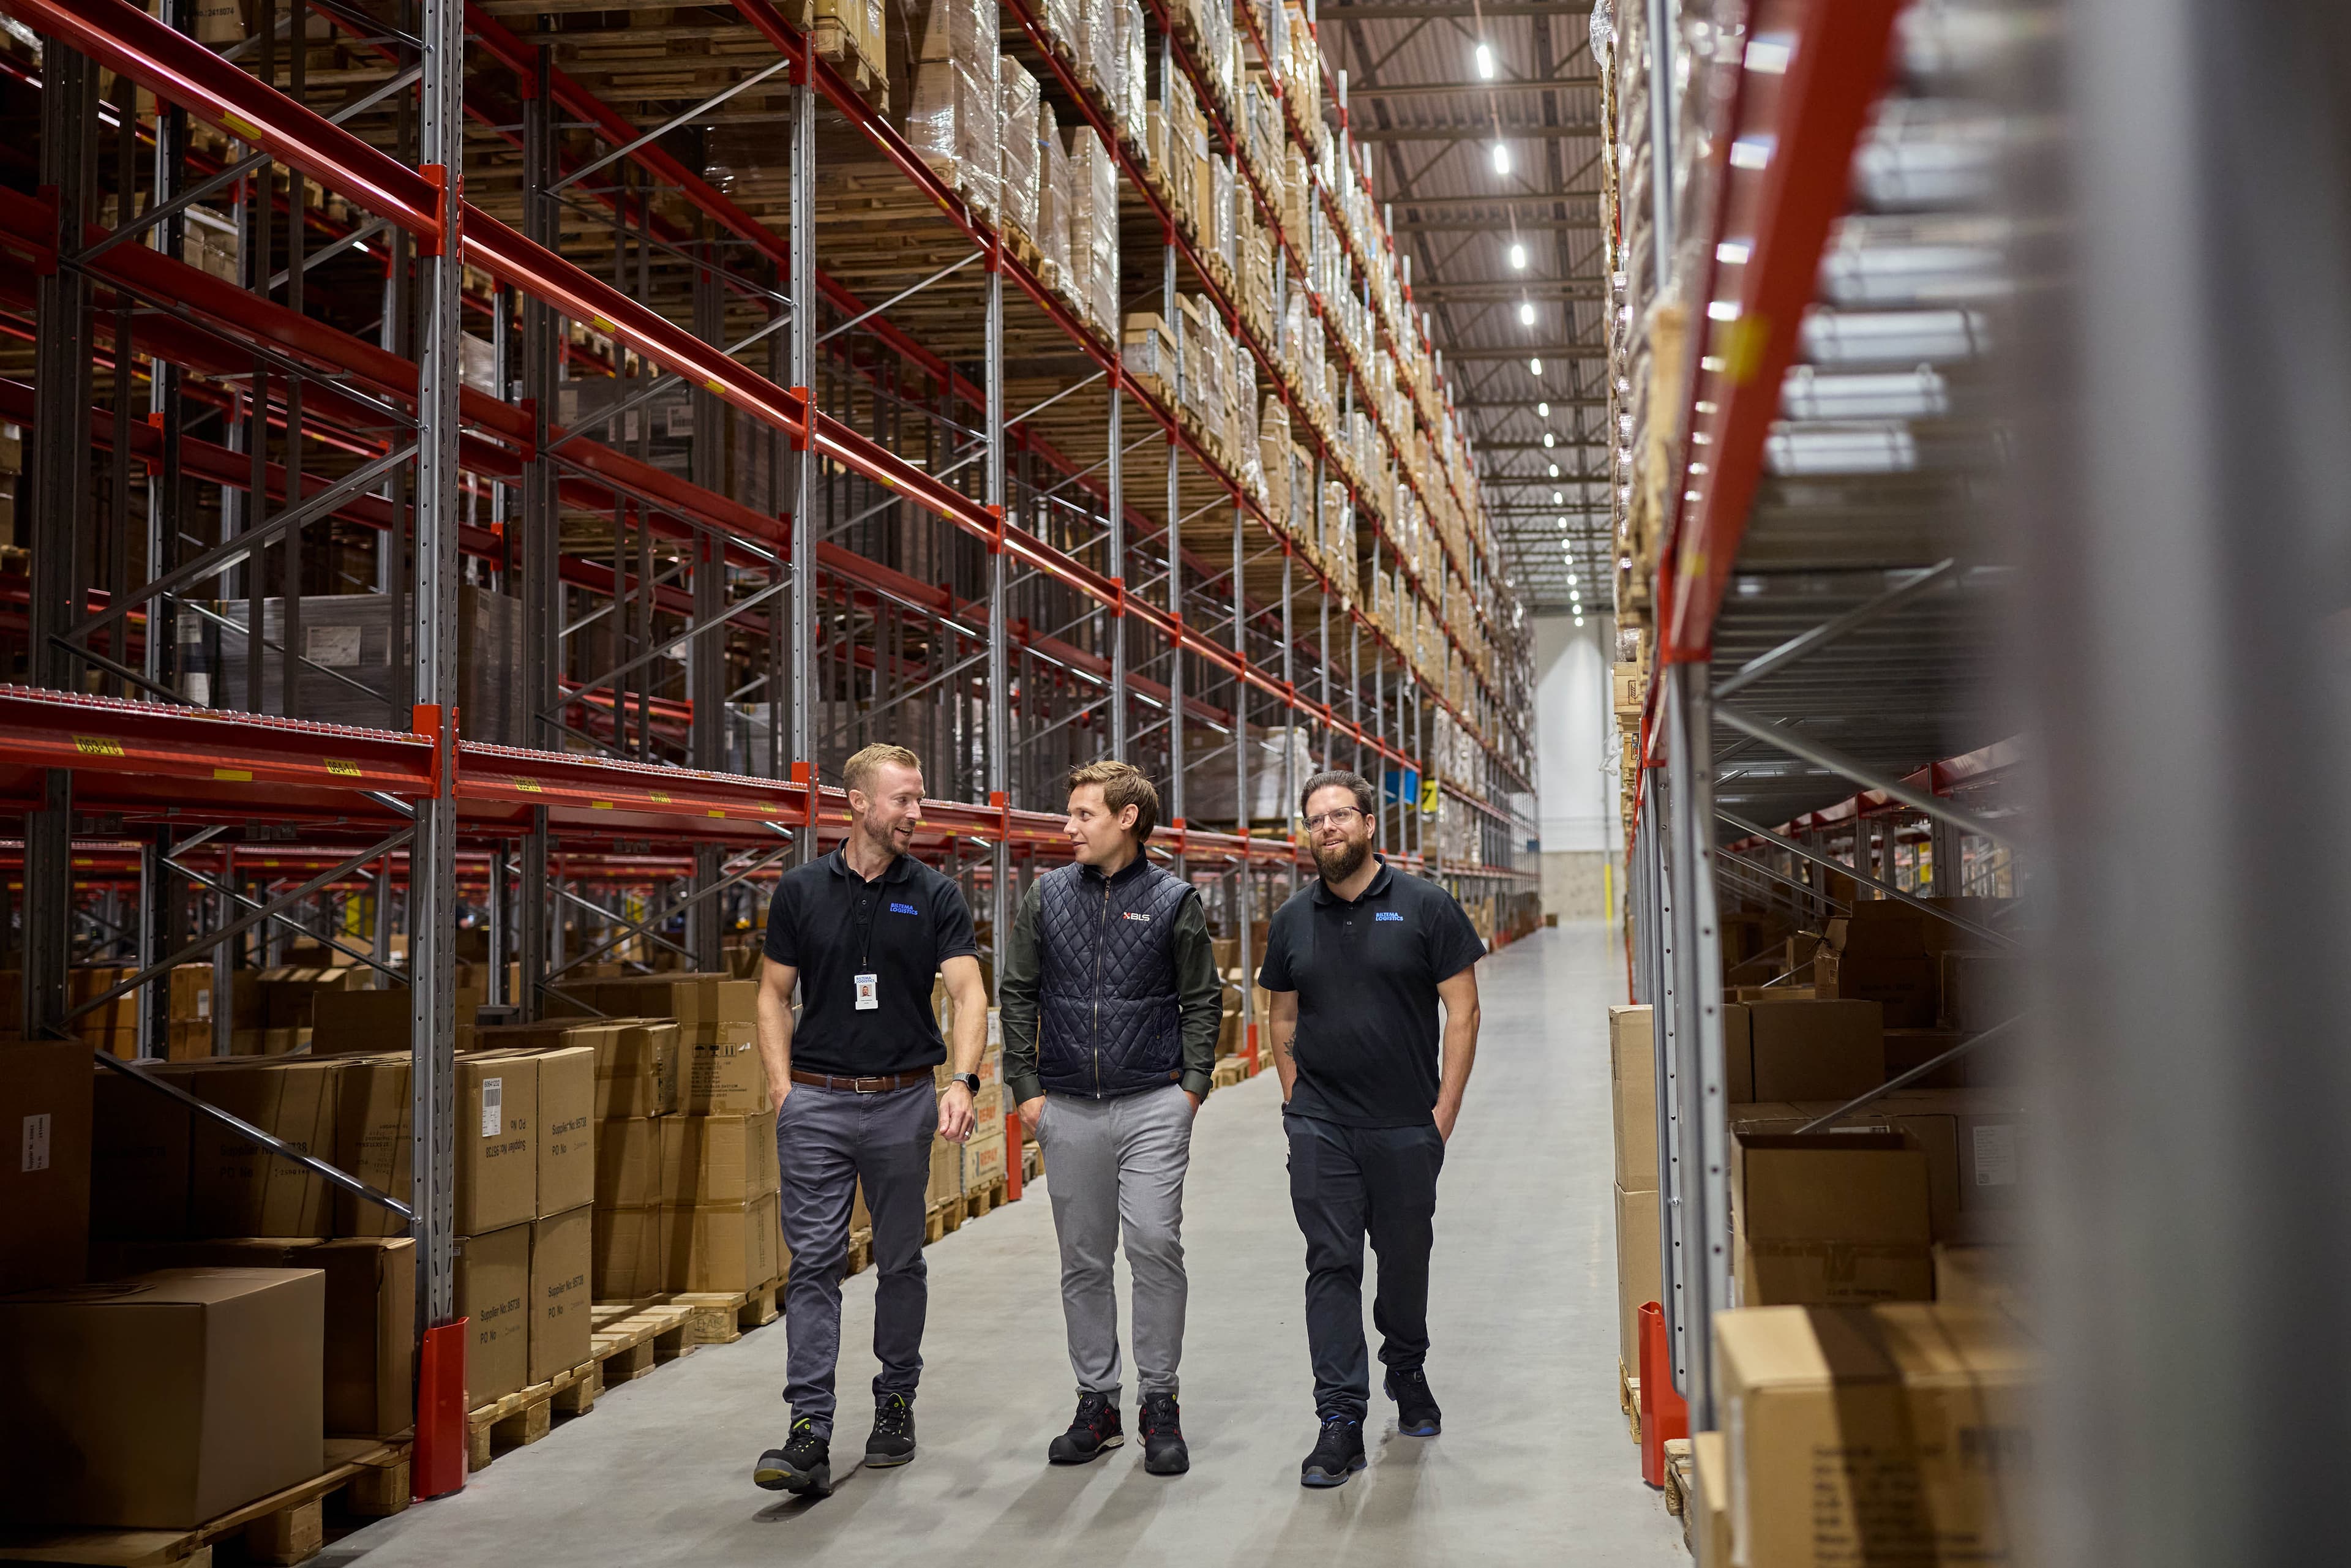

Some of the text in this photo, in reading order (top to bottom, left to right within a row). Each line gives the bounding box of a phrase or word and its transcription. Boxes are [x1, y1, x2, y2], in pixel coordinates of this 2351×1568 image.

[1130, 913, 1150, 921] BLS
[548, 1283, 565, 1298] Supplier
[481, 1306, 500, 1322] Supplier
[480, 1332, 488, 1345] PO
